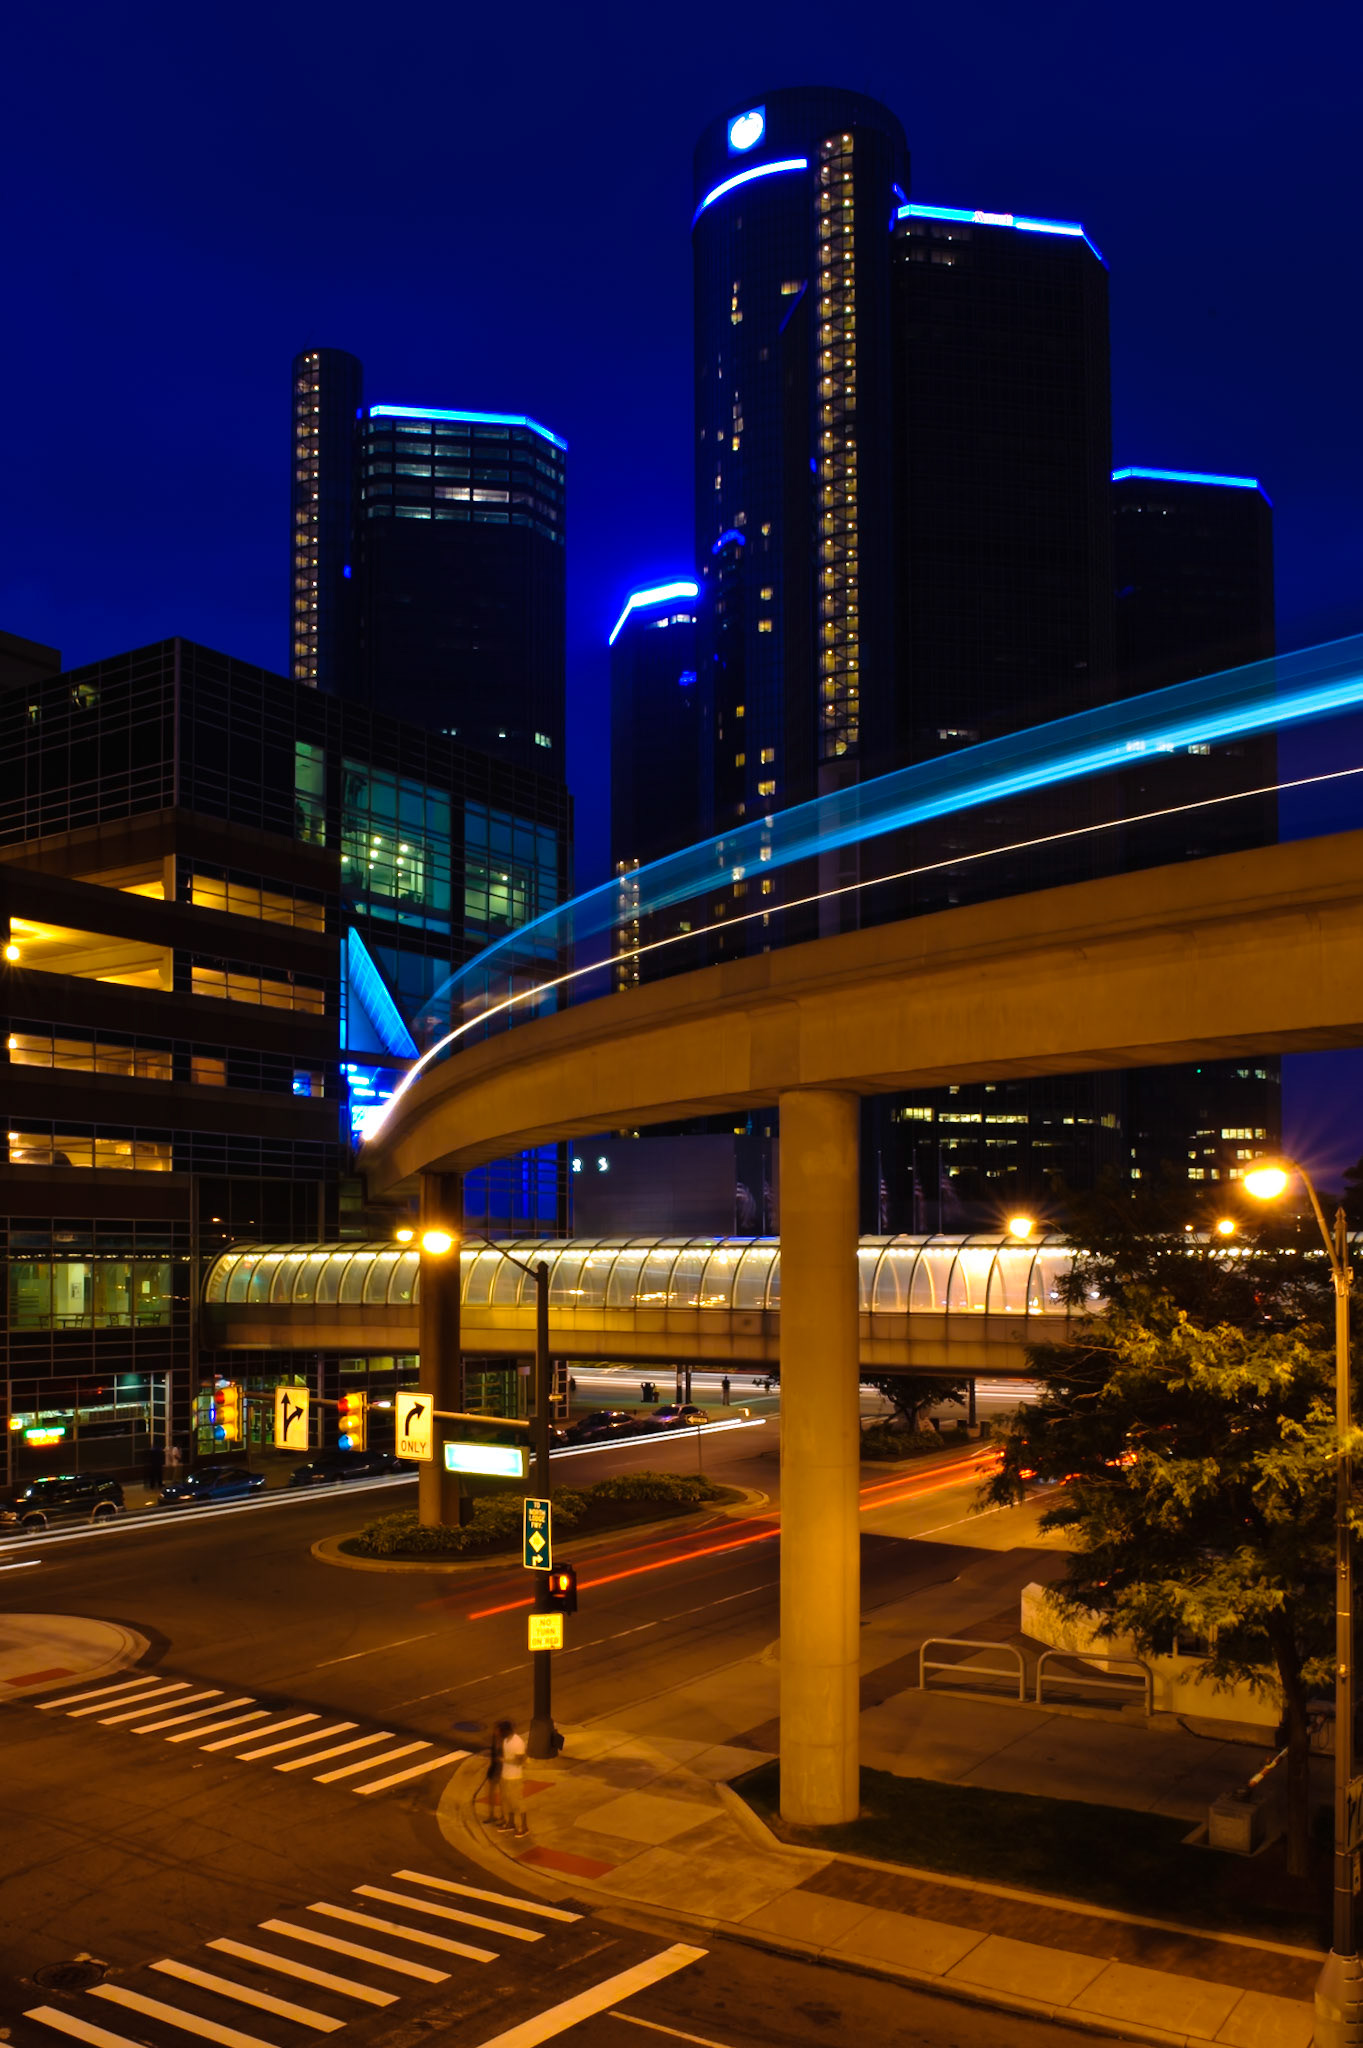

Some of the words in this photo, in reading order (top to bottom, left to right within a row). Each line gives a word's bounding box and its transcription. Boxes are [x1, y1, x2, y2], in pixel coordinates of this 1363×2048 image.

[400, 1439, 427, 1454] ONLY
[540, 1618, 552, 1626] NO
[536, 1627, 556, 1636] TURN
[531, 1637, 542, 1646] ON
[545, 1636, 559, 1645] RED
